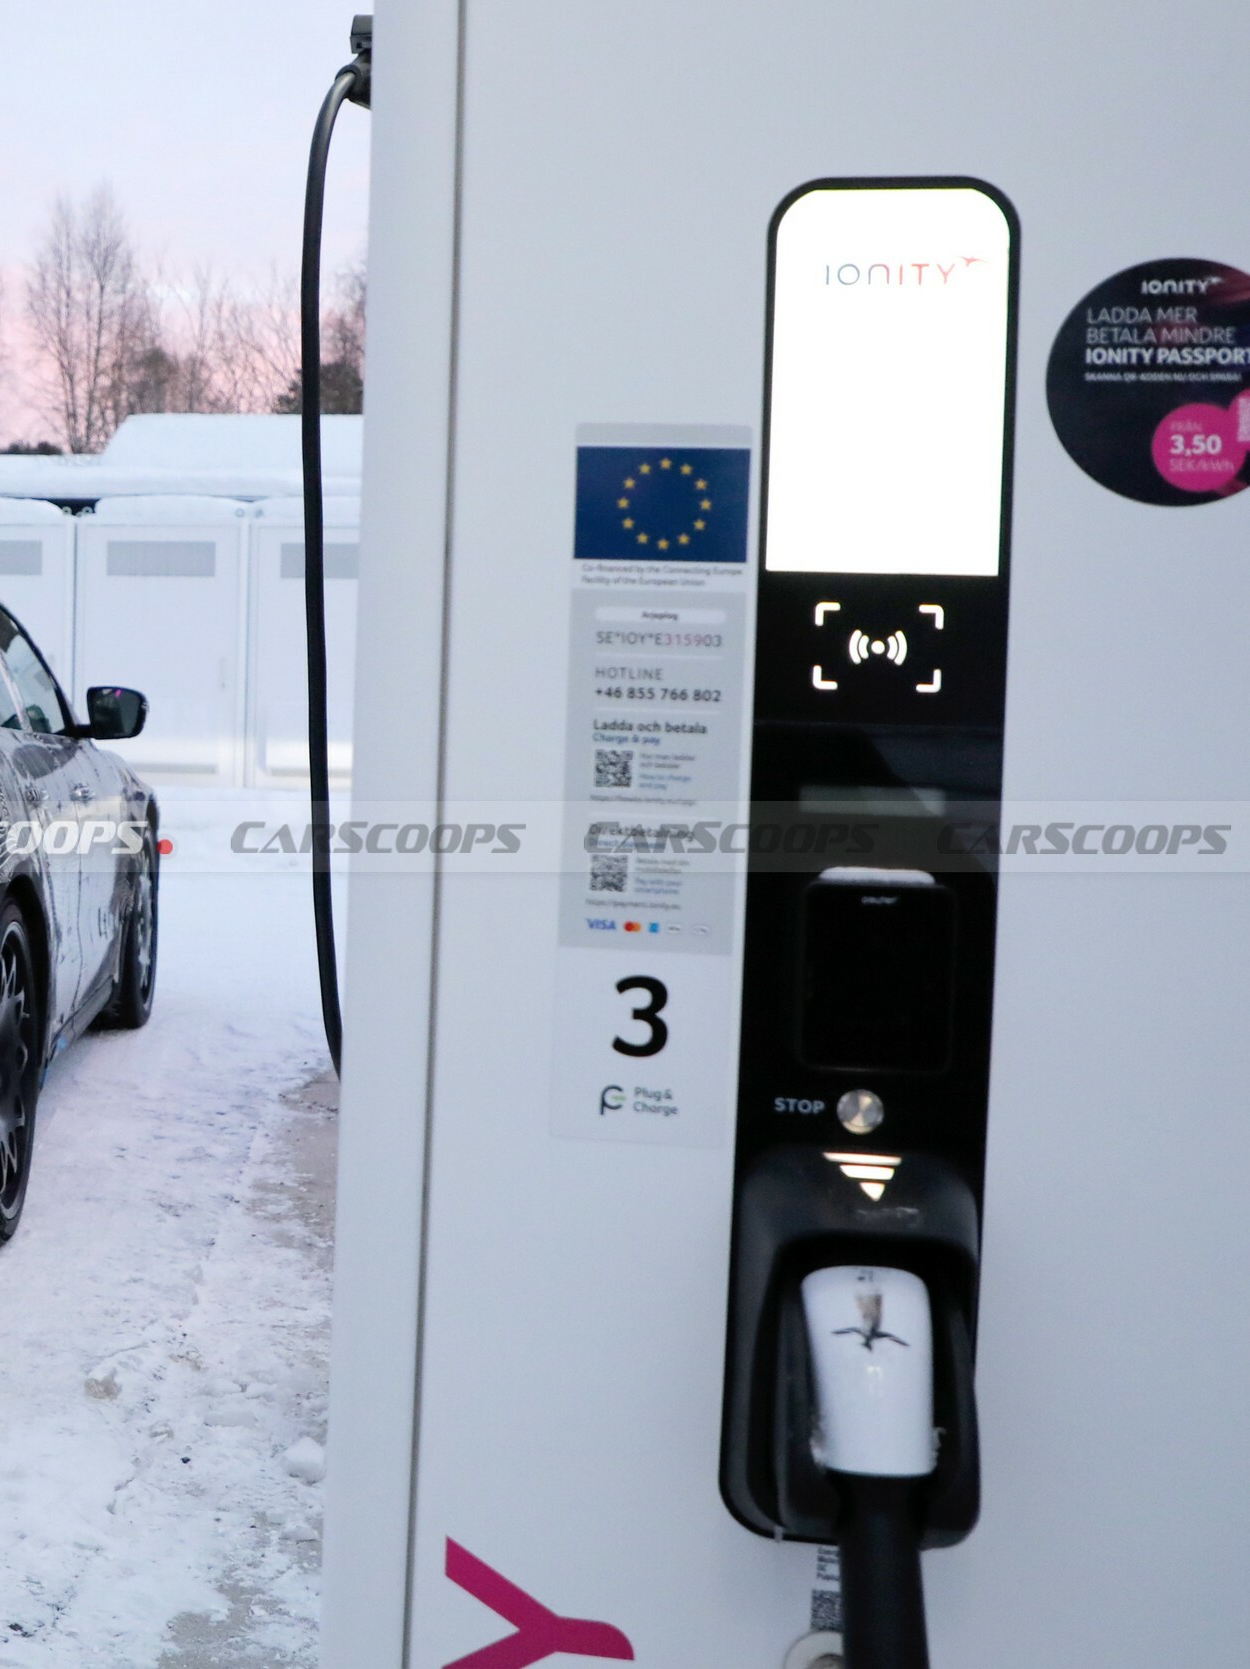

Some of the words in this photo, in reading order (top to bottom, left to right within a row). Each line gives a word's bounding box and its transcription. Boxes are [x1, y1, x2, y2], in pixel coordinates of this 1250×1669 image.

[826, 263, 955, 286] IONITY
[1141, 278, 1208, 294] IONITY
[1086, 306, 1151, 324] LADDA
[1156, 306, 1198, 324] MER
[1086, 326, 1156, 344] BETALA
[1160, 326, 1236, 344] MINDRE
[1085, 347, 1154, 365] IONITY
[1170, 434, 1222, 456] 3,50
[595, 666, 663, 681] HOTLINE
[595, 686, 622, 699] +46
[627, 687, 655, 700] 855
[660, 688, 688, 701] 766
[692, 689, 721, 702] 802
[593, 719, 633, 732] Ladda
[637, 721, 661, 733] och
[664, 722, 707, 735] betala
[587, 919, 617, 930] VISA
[612, 975, 668, 1057] 3
[634, 1087, 662, 1101] Plug
[664, 1089, 673, 1100] &
[633, 1101, 679, 1116] Charge
[774, 1097, 826, 1114] STOP
